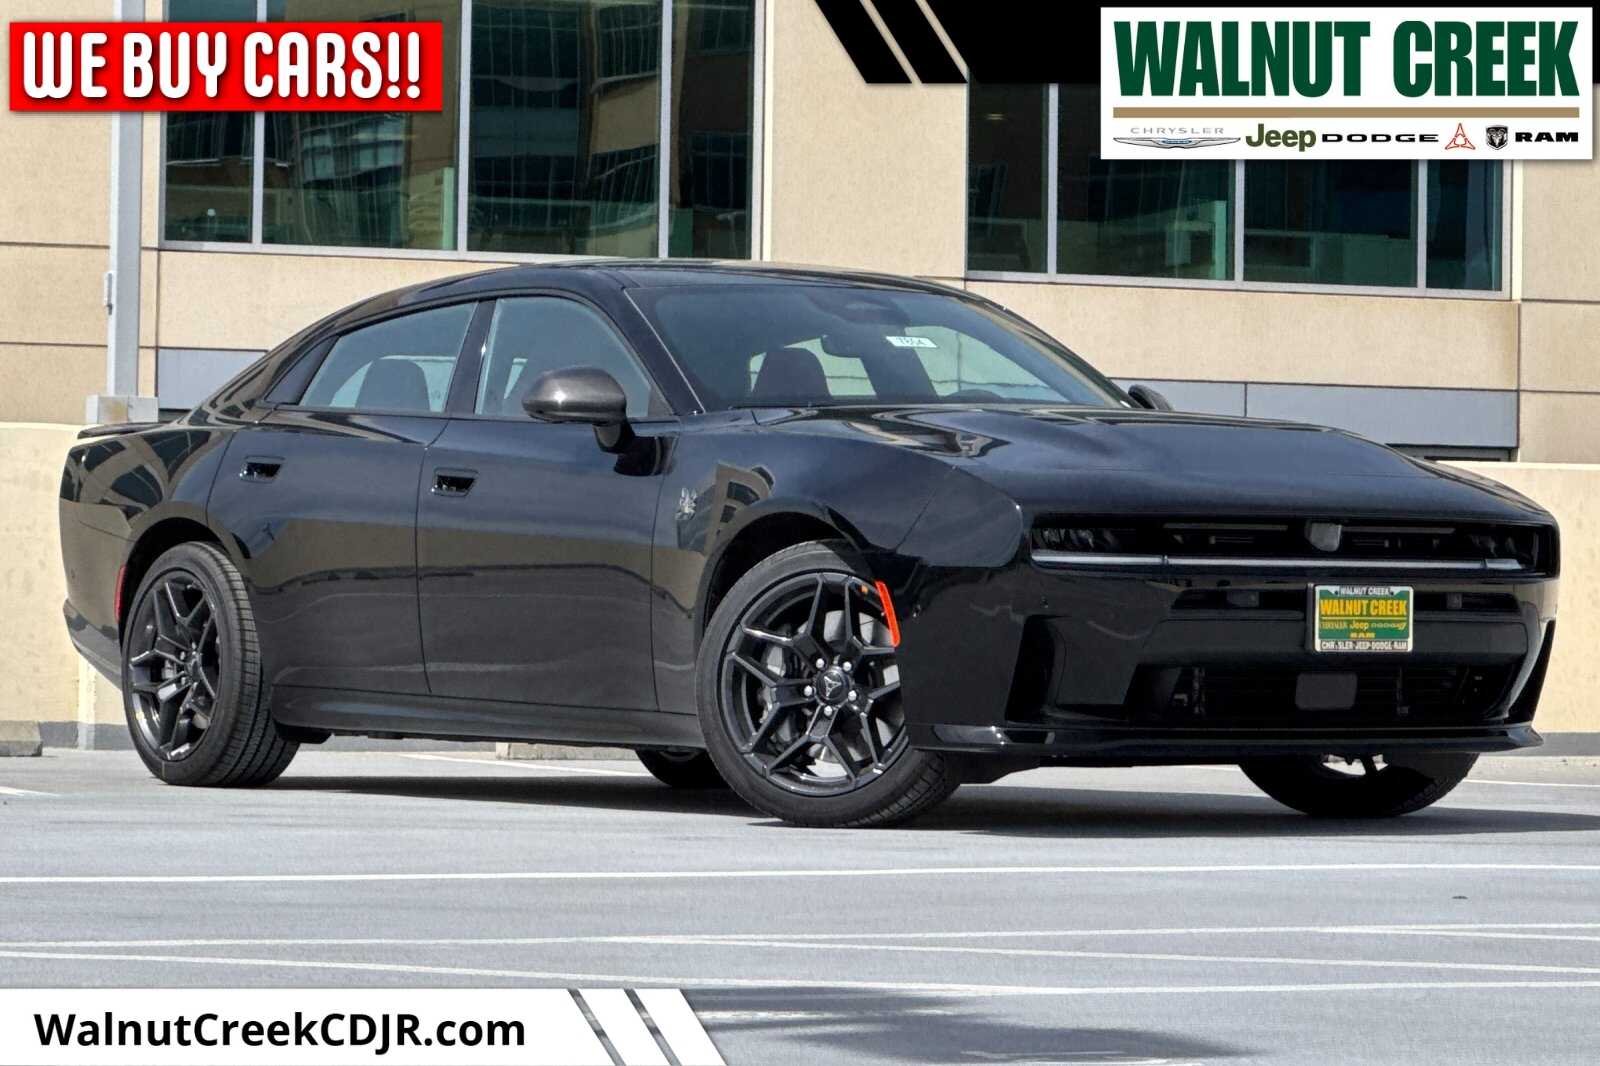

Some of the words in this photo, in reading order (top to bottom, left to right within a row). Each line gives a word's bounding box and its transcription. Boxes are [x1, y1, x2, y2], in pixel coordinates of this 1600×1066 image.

[1320, 599, 1369, 616] WALNUT
[1370, 599, 1408, 616] CREEK
[1350, 619, 1369, 631] Jeep
